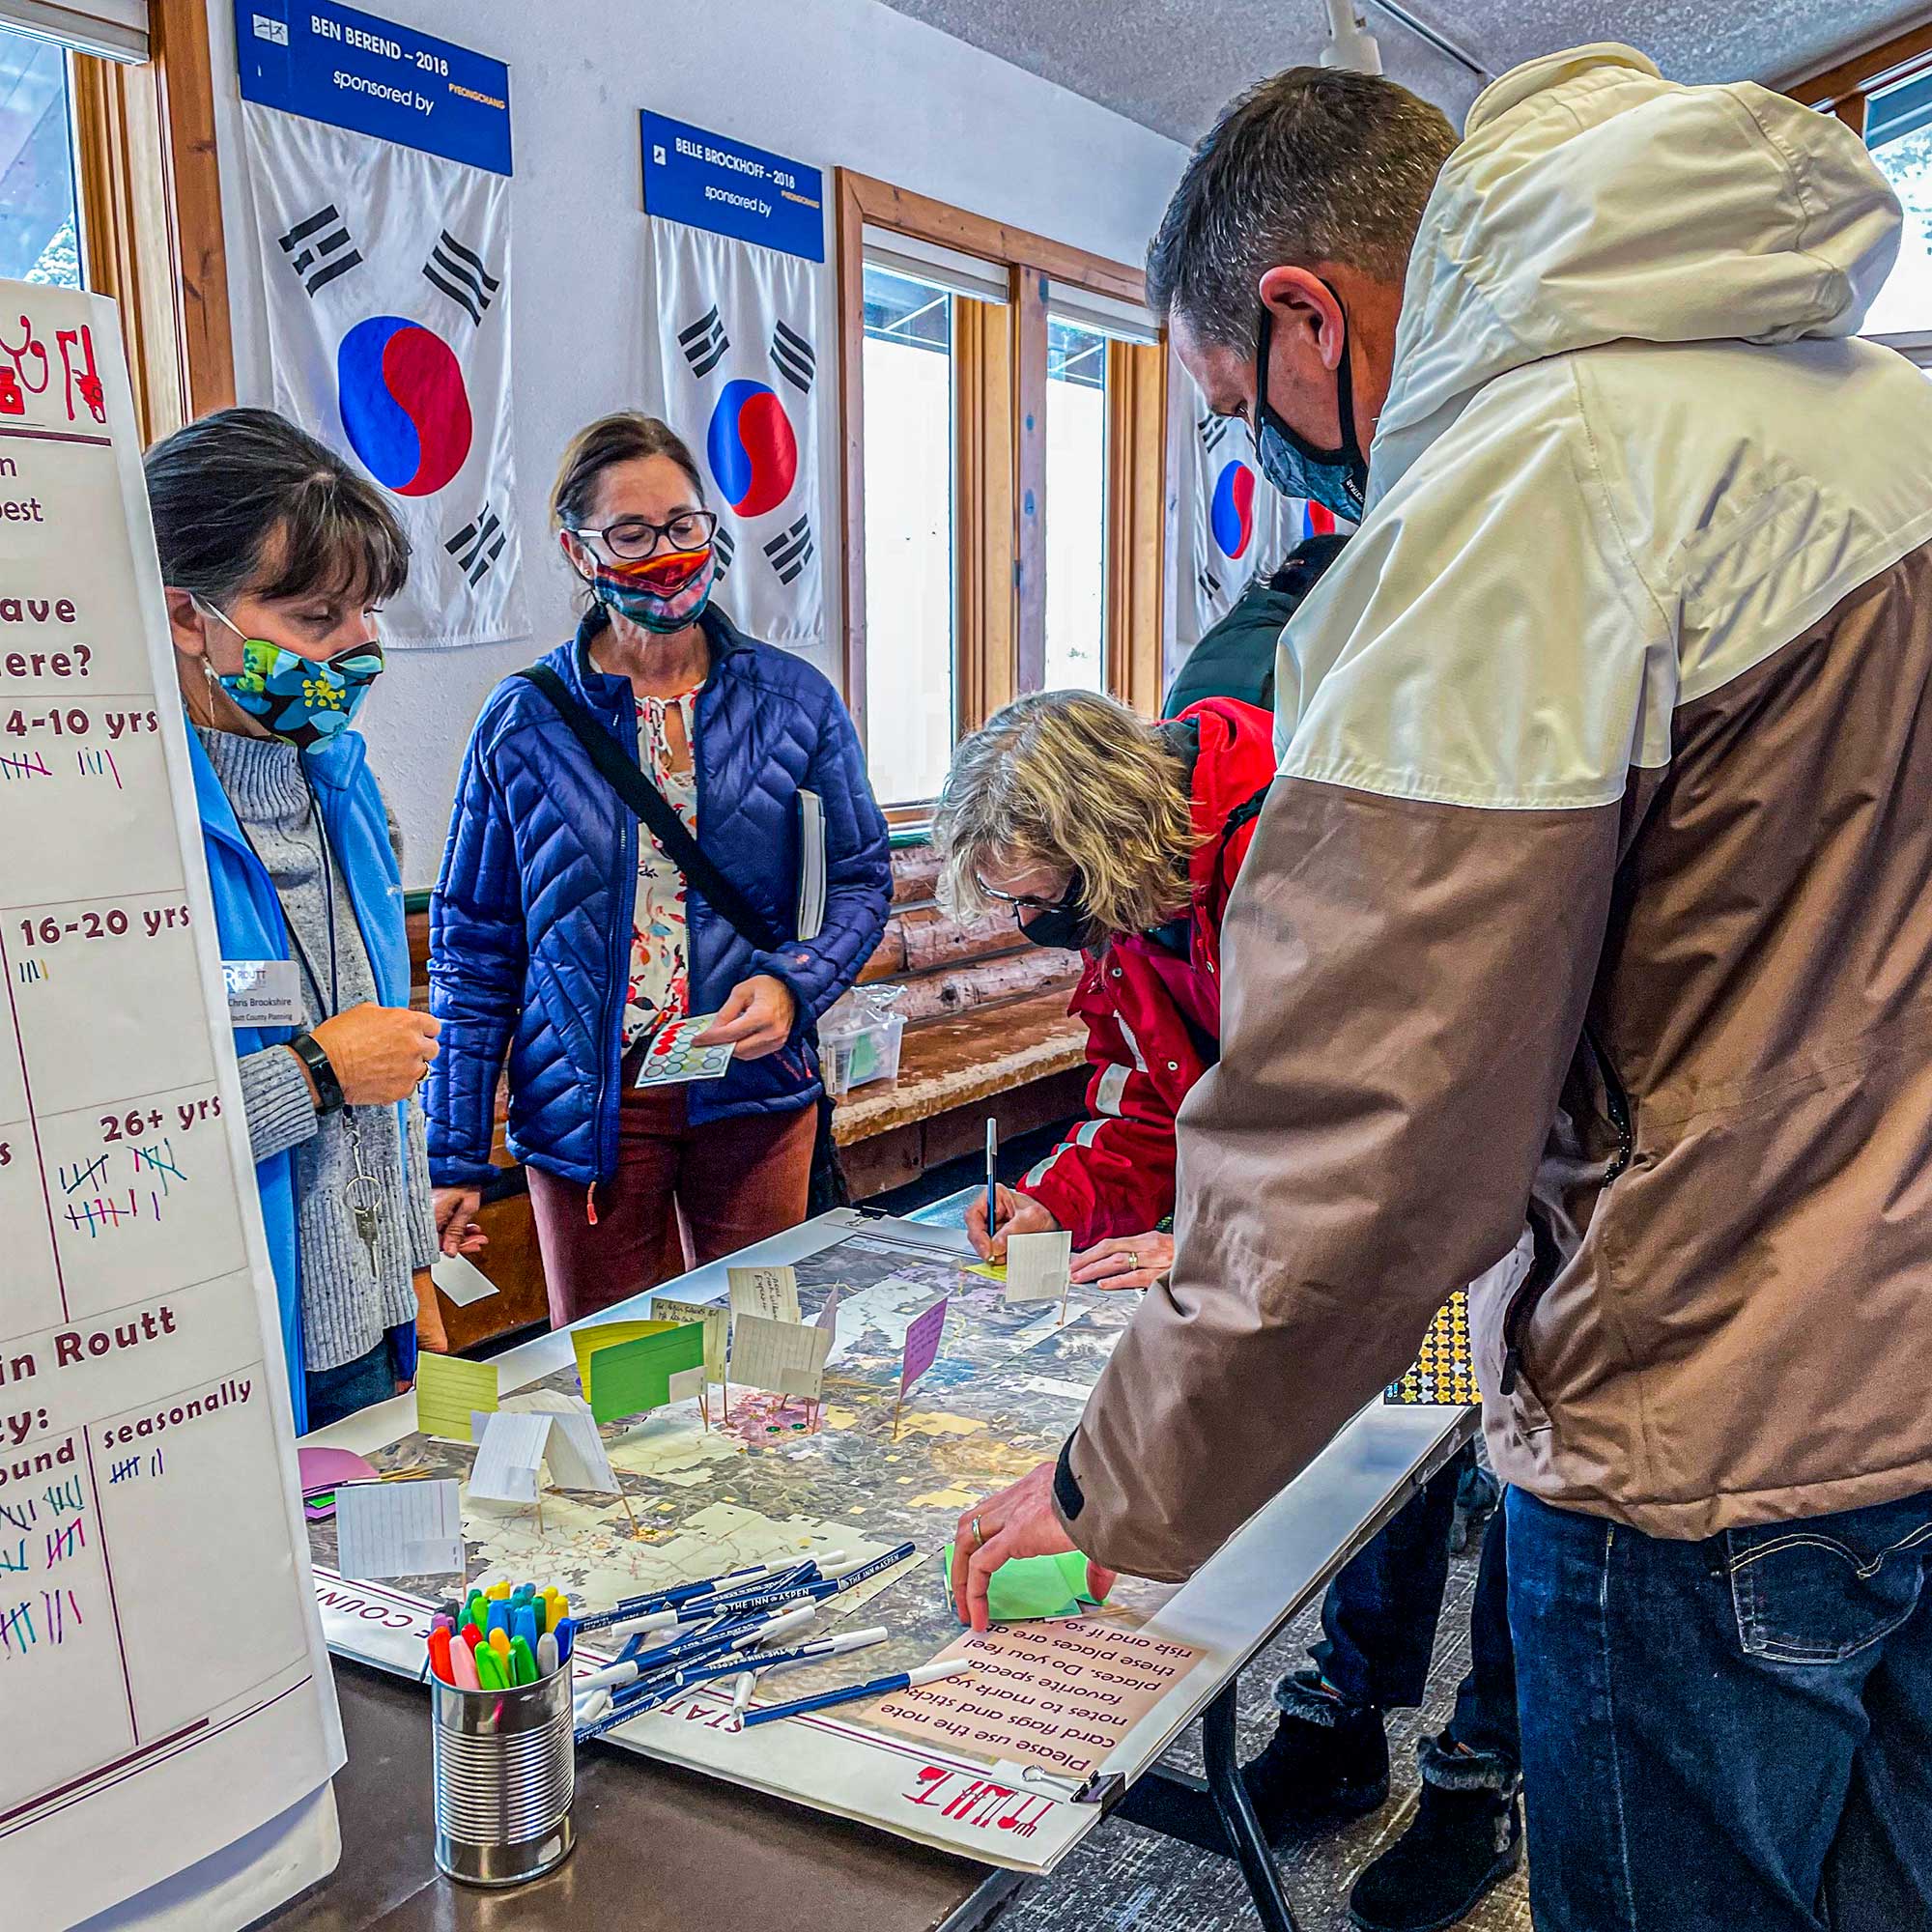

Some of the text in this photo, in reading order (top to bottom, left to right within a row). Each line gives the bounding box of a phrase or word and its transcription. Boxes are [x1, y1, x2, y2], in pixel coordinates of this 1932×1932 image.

[310, 14, 341, 43] BEN
[344, 25, 402, 61] BEREND
[415, 50, 449, 77] 2018
[332, 70, 435, 117] sponsored by
[675, 137, 703, 160] BELLE
[704, 147, 765, 179] BROCKHOFF
[773, 170, 796, 190] 2018
[704, 185, 758, 212] sponsored
[758, 197, 773, 218] by
[0, 497, 44, 523] est
[0, 644, 92, 677] ere?
[104, 709, 159, 740] yrs
[19, 904, 190, 947] 16-20 yrs
[228, 997, 248, 1007] Chris
[99, 1094, 222, 1143] 26+ yrs
[54, 1305, 178, 1368] Routt
[102, 1378, 253, 1449] seasonally
[849, 1553, 900, 1586] THE INN ASPEN
[315, 1587, 413, 1628] COUN
[728, 1589, 810, 1611] THE INN ASPEN
[1012, 1630, 1047, 1646] are
[1086, 1627, 1105, 1640] if
[1106, 1630, 1151, 1648] and
[963, 1638, 1161, 1694] places. Do you feel
[1053, 1639, 1117, 1662] places
[1154, 1643, 1193, 1661] risk
[1120, 1655, 1176, 1679] these
[967, 1660, 1123, 1707] favorite specia
[976, 1685, 1037, 1706] mark
[658, 1699, 742, 1733] STAT
[959, 1702, 1003, 1723] and
[1040, 1701, 1064, 1717] to
[1068, 1707, 1127, 1729] notes
[881, 1704, 1091, 1772] Please use the note
[1008, 1714, 1059, 1736] flags
[1060, 1727, 1115, 1750] card
